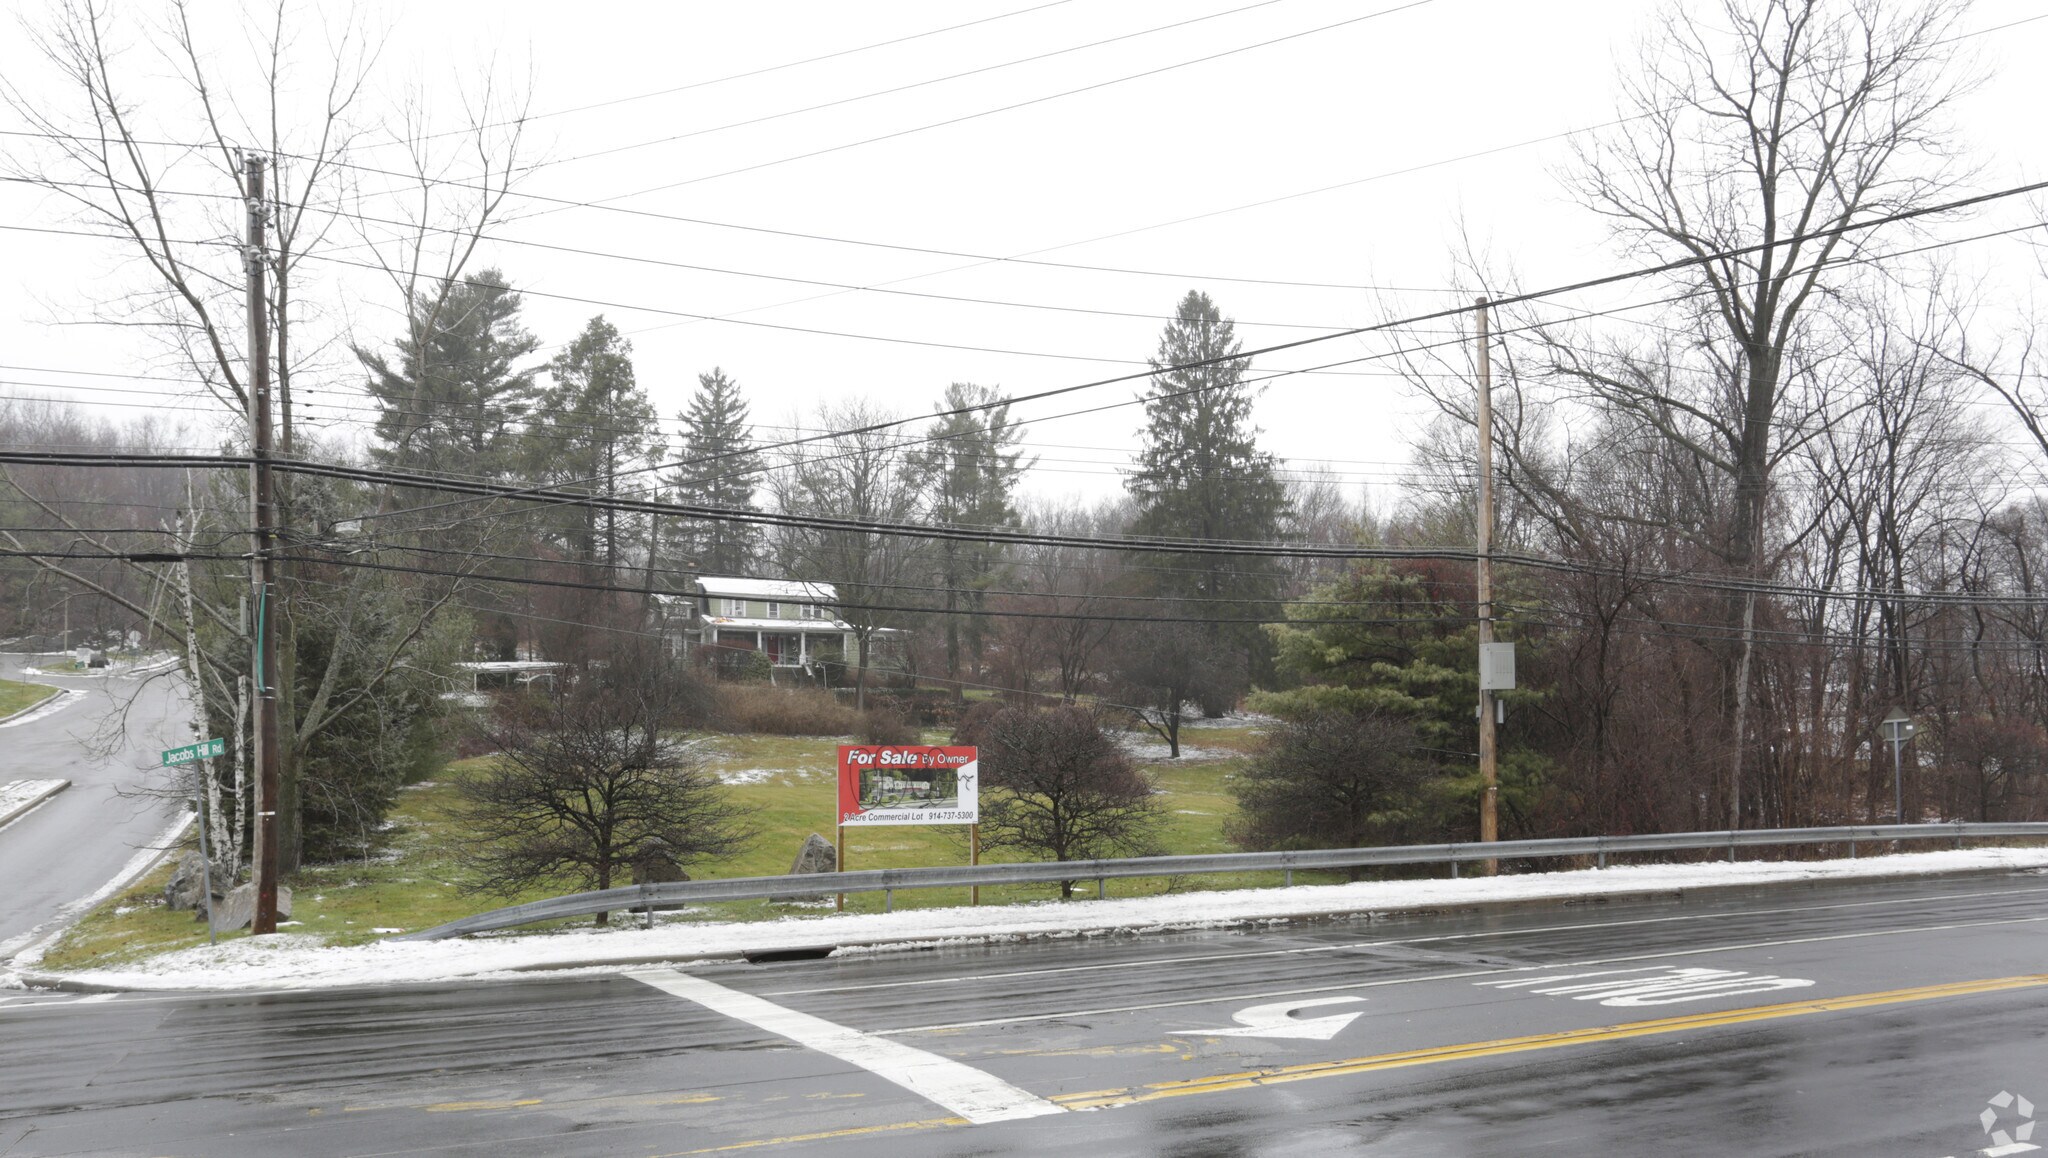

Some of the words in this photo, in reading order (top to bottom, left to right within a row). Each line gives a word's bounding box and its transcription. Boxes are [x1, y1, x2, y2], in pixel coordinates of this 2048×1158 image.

[166, 749, 194, 764] Jacobs
[197, 744, 209, 757] Hill
[212, 744, 222, 753] Rd
[847, 750, 876, 764] For
[880, 750, 918, 764] Sale
[922, 754, 935, 766] By
[937, 753, 969, 764] Owner
[849, 813, 867, 821] Acre
[868, 812, 910, 821] Commercial
[912, 812, 923, 821] Lot
[928, 811, 974, 820] 914-737-5300
